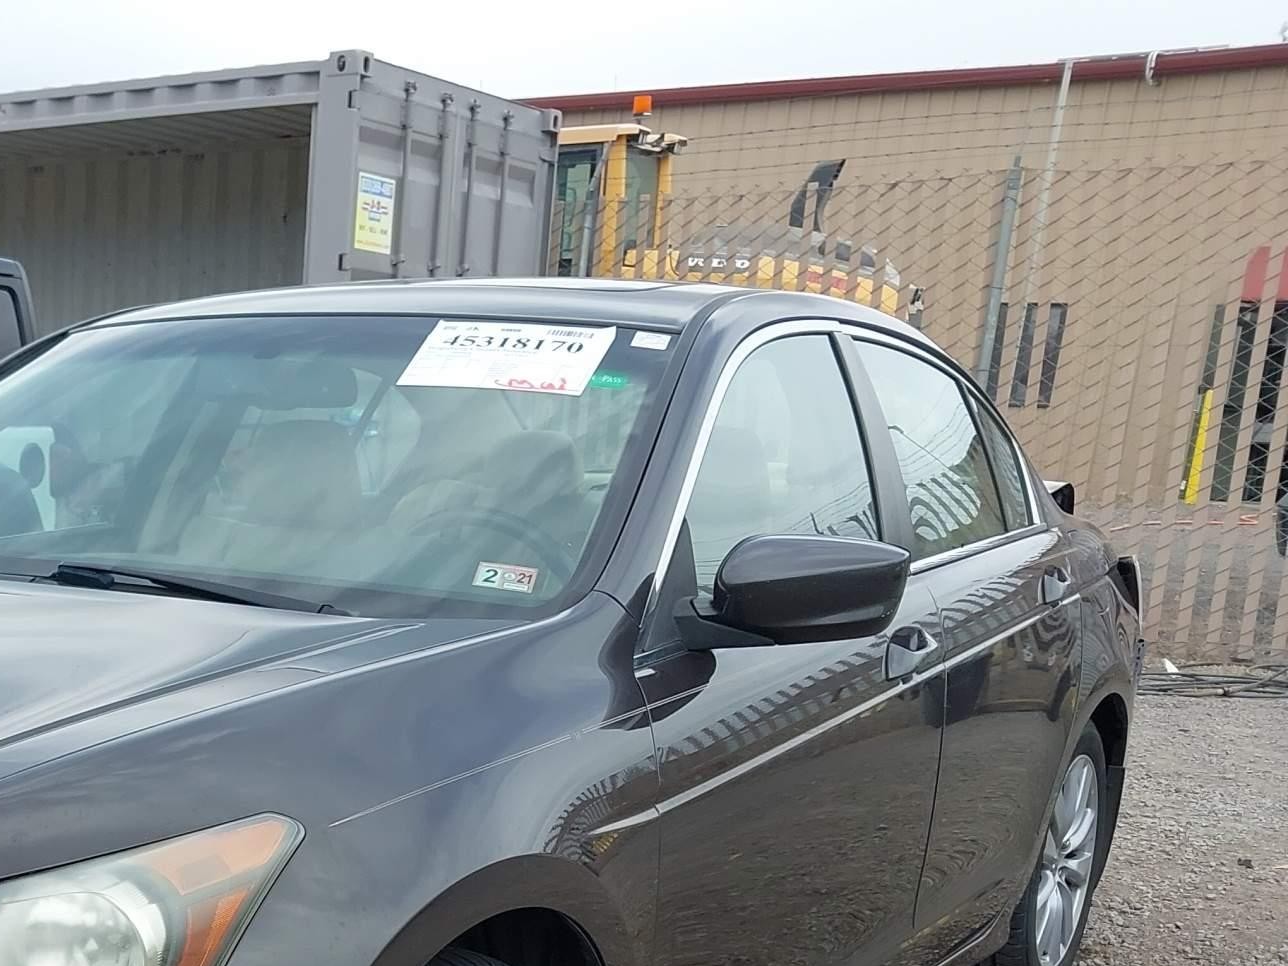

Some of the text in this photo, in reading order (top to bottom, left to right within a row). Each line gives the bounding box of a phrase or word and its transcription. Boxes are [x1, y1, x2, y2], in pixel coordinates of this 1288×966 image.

[443, 333, 584, 354] 45318170
[482, 568, 499, 584] 2
[516, 572, 534, 585] 21
